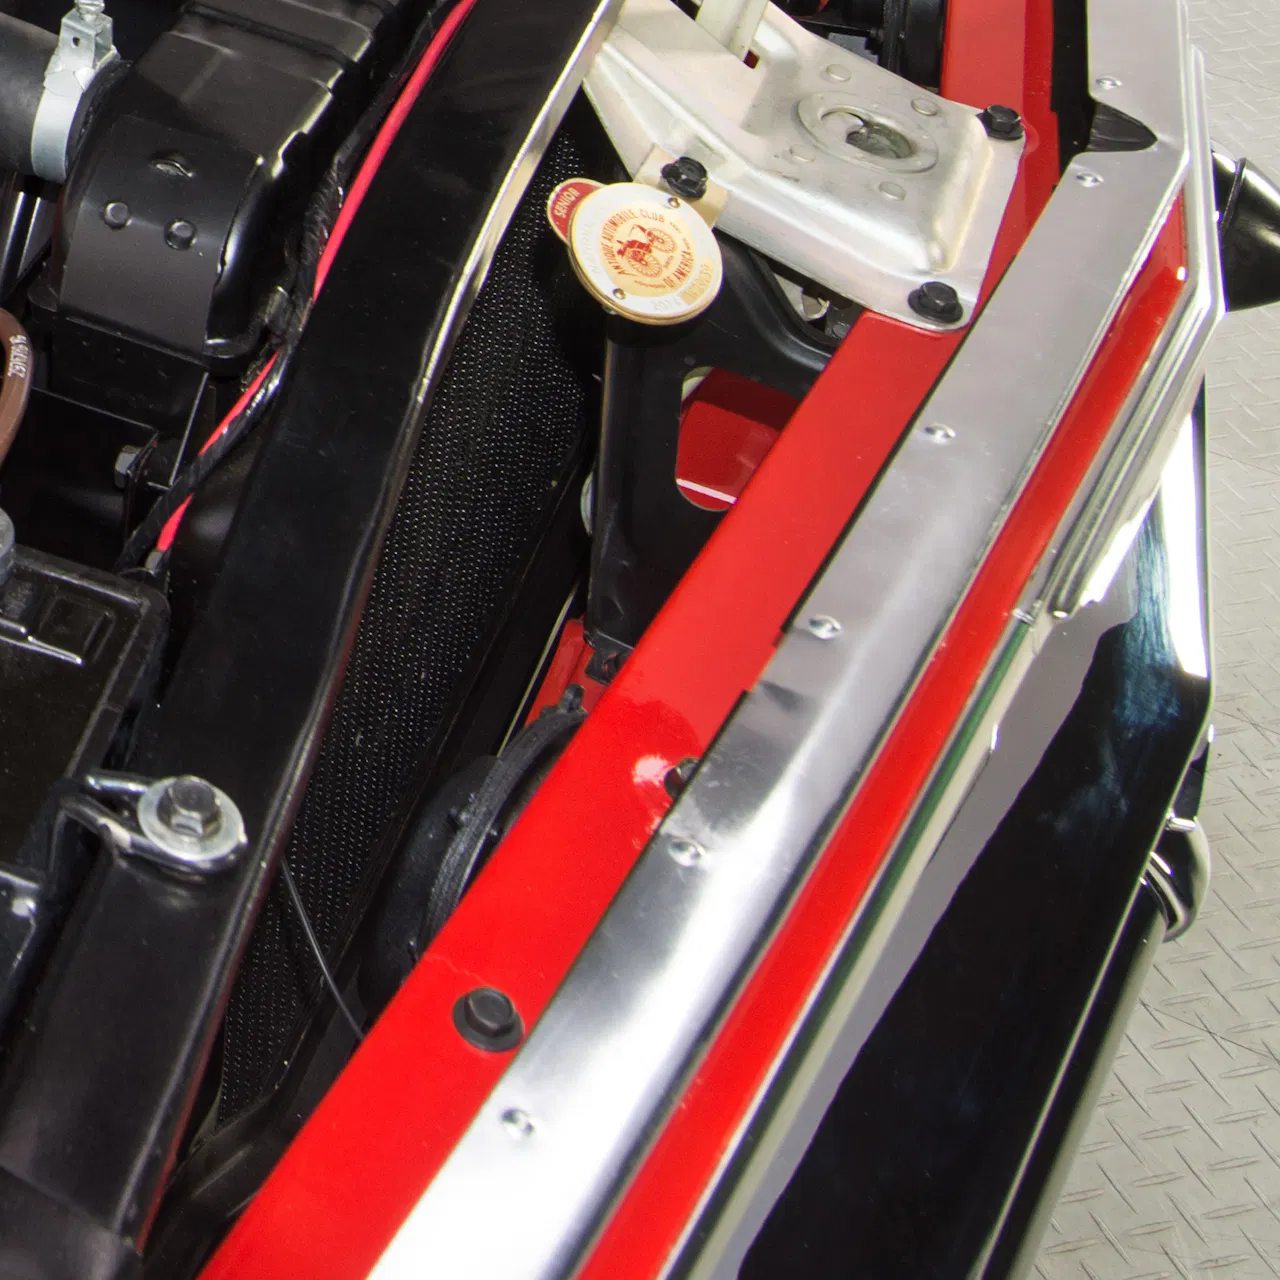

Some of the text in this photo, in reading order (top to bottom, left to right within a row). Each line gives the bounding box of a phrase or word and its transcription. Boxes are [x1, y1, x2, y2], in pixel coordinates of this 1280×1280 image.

[554, 187, 581, 219] SENIOR
[602, 208, 639, 243] AUTOMOBILE
[639, 209, 665, 223] CLUB
[664, 277, 676, 288] OF
[674, 250, 695, 283] AMERICA
